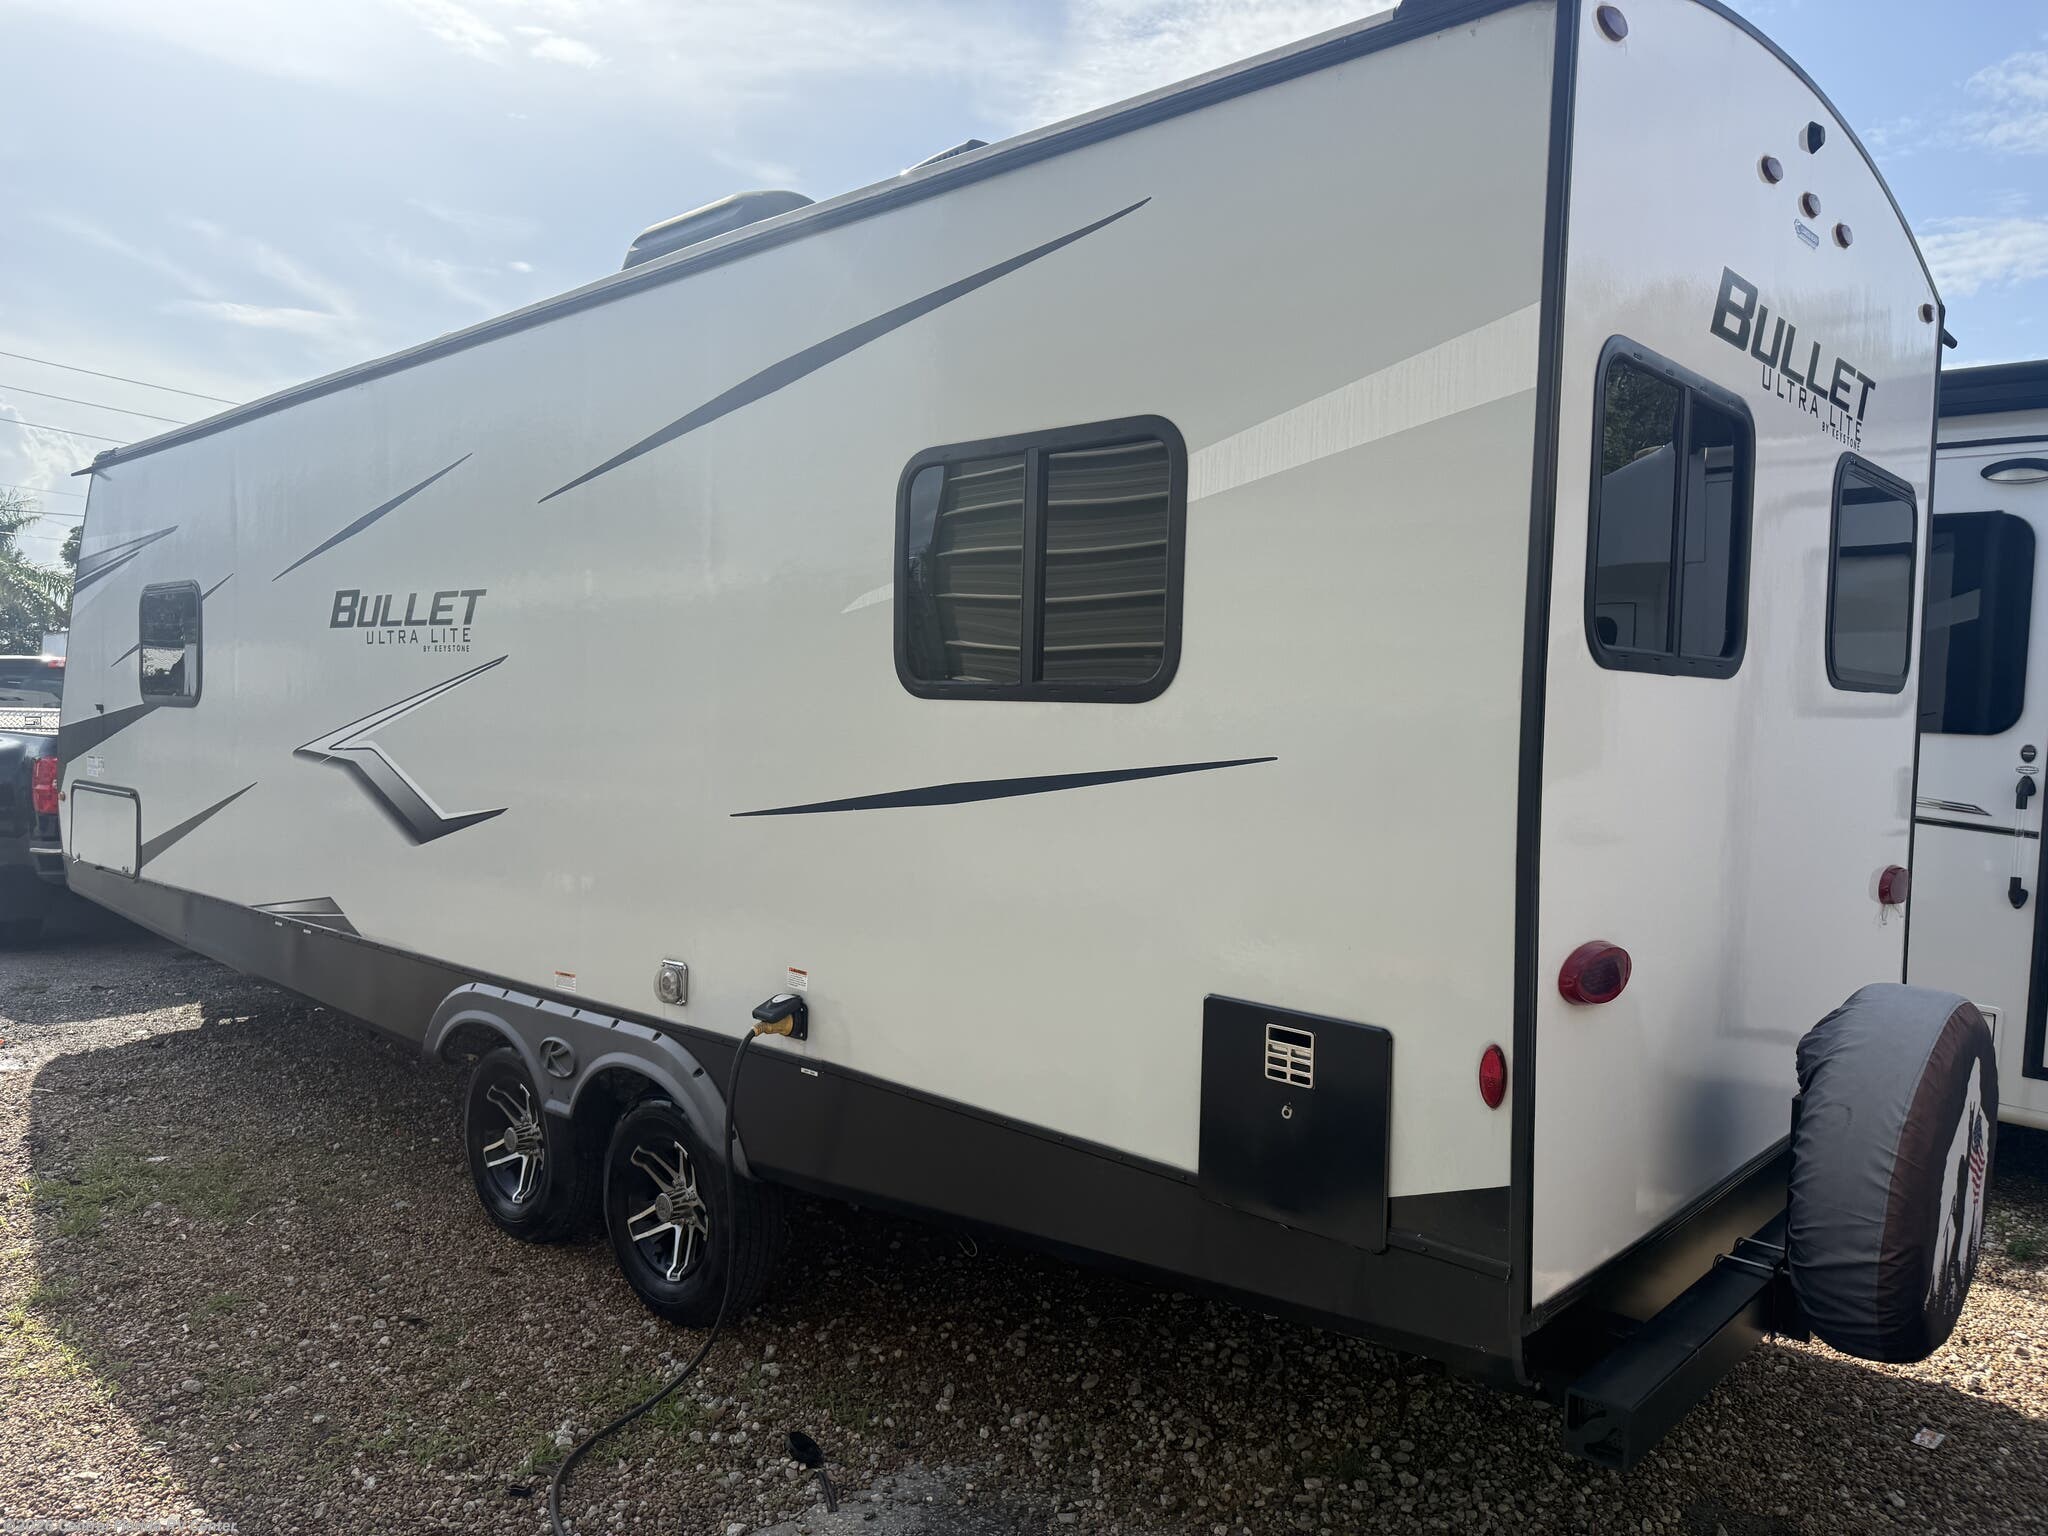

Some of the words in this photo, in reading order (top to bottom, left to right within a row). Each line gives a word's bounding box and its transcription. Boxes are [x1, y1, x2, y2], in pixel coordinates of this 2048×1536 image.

[1710, 265, 1876, 421] BULLET
[1762, 364, 1819, 418] ULTRA
[1829, 405, 1862, 443] LITE
[1822, 421, 1830, 433] BY
[1832, 428, 1860, 451] KEYSTONE
[330, 589, 487, 628] BULLET
[366, 629, 419, 645] ULTRA
[430, 627, 471, 643] LITE
[423, 644, 431, 653] BY
[433, 644, 470, 653] KEYSTONE
